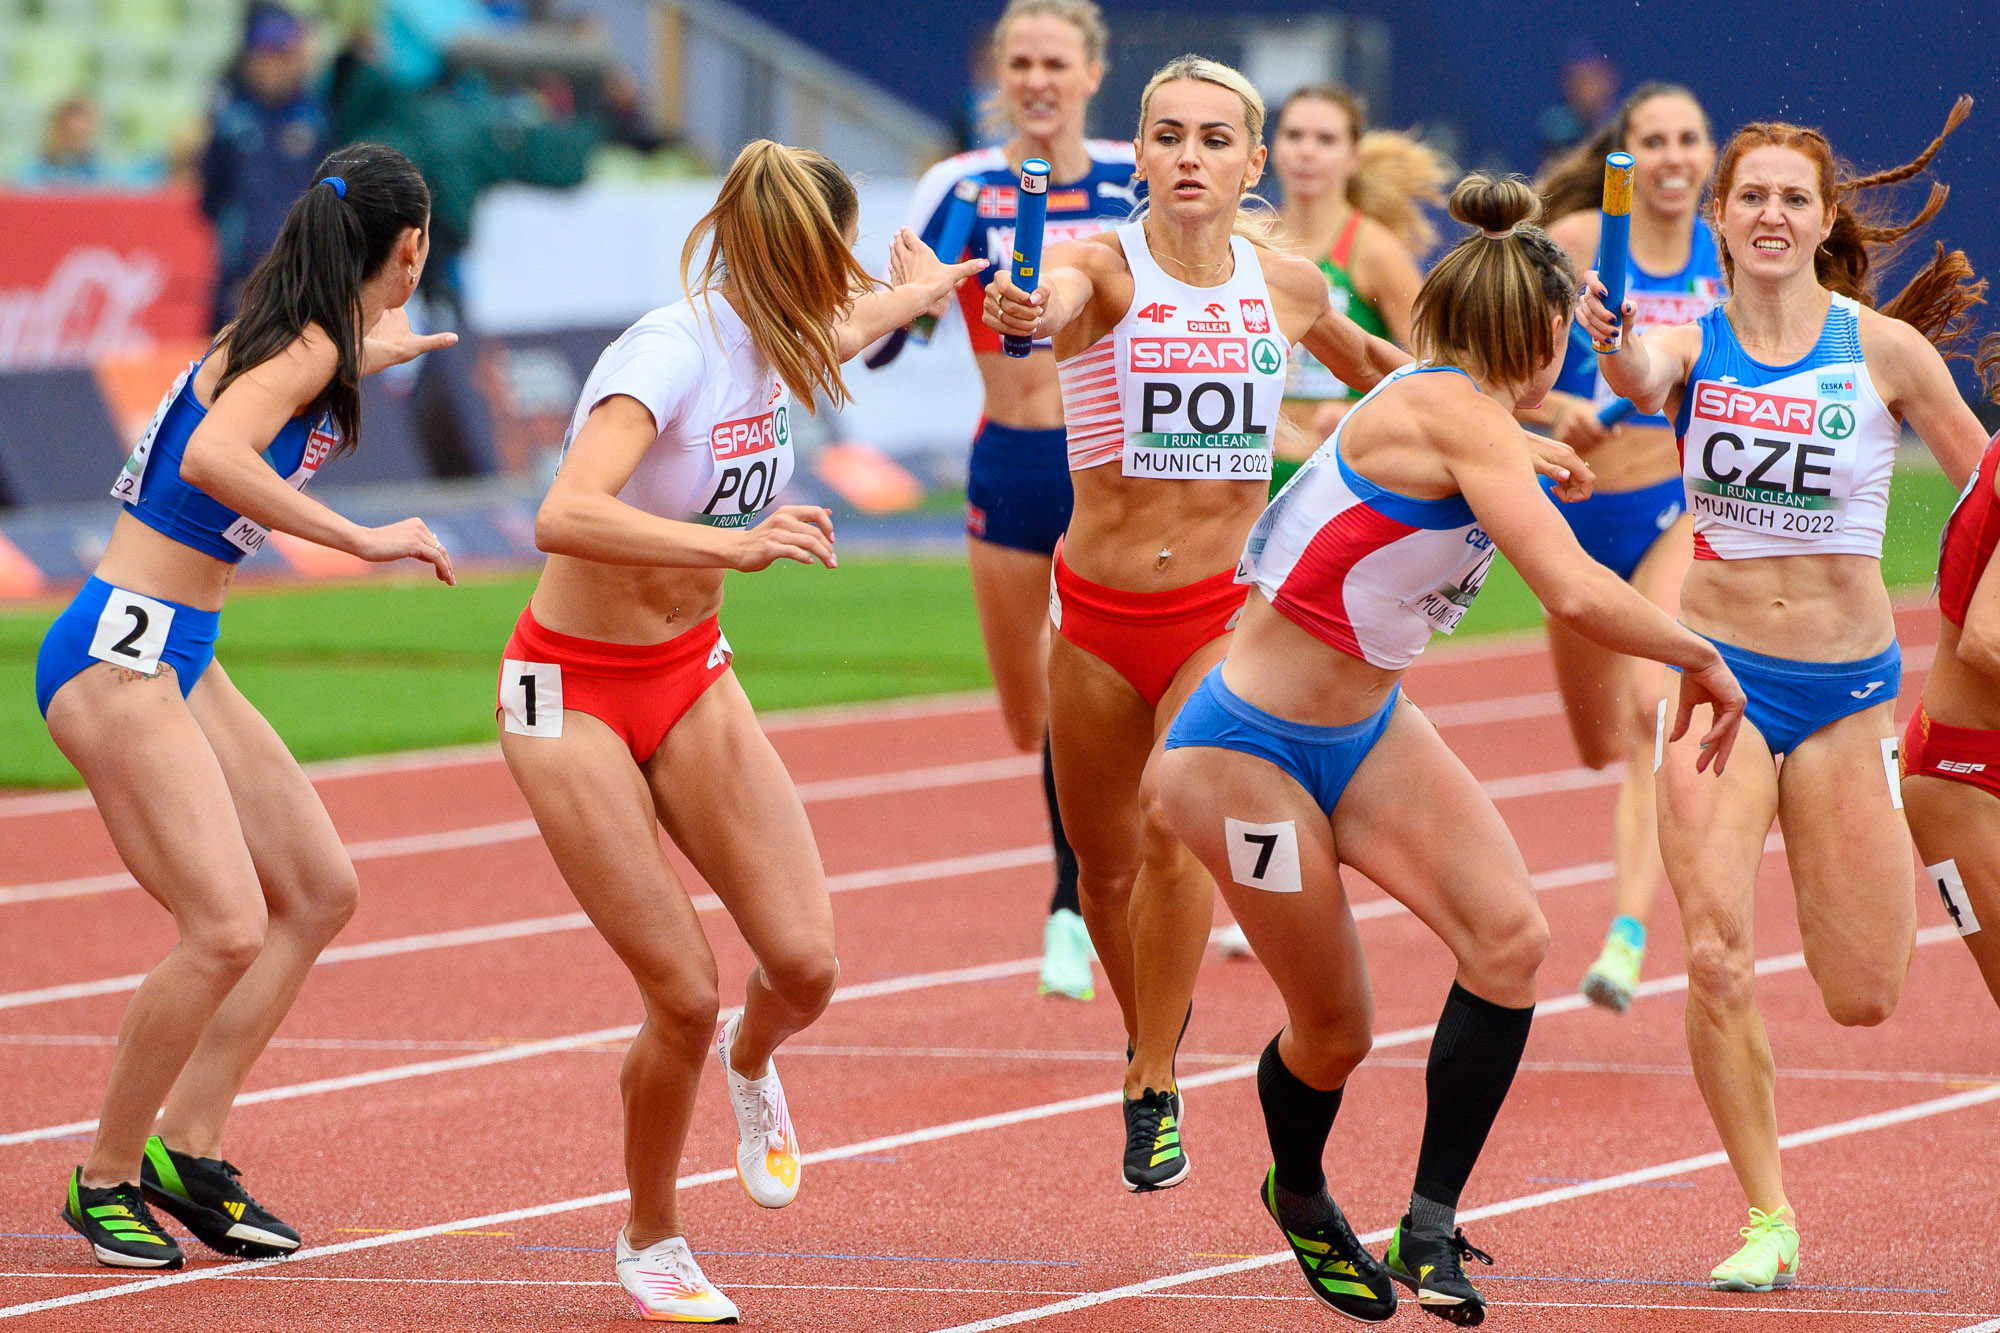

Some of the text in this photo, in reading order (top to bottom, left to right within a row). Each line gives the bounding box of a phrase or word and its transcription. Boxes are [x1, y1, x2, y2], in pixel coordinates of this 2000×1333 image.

[1137, 302, 1177, 324] 4F
[1189, 322, 1228, 332] ORLEN
[1134, 342, 1246, 368] SPAR
[1141, 382, 1267, 435] POL
[1699, 388, 1812, 431] SPAR
[713, 418, 774, 455] SPAR
[1163, 436, 1167, 447] I
[1171, 435, 1200, 447] RUN
[1133, 452, 1268, 473] MUNICH 2022
[1702, 431, 1836, 497] CZE
[702, 457, 778, 514] POL
[1718, 484, 1723, 495] I
[1727, 487, 1756, 501] RUN
[712, 516, 719, 527] I
[718, 515, 741, 527] RUN
[1694, 495, 1835, 534] MUNICH 2022
[110, 605, 149, 659] 2
[519, 675, 536, 726] 1
[1936, 759, 1986, 774] ESP
[1244, 832, 1279, 880] 7
[1938, 878, 1963, 928] 4
